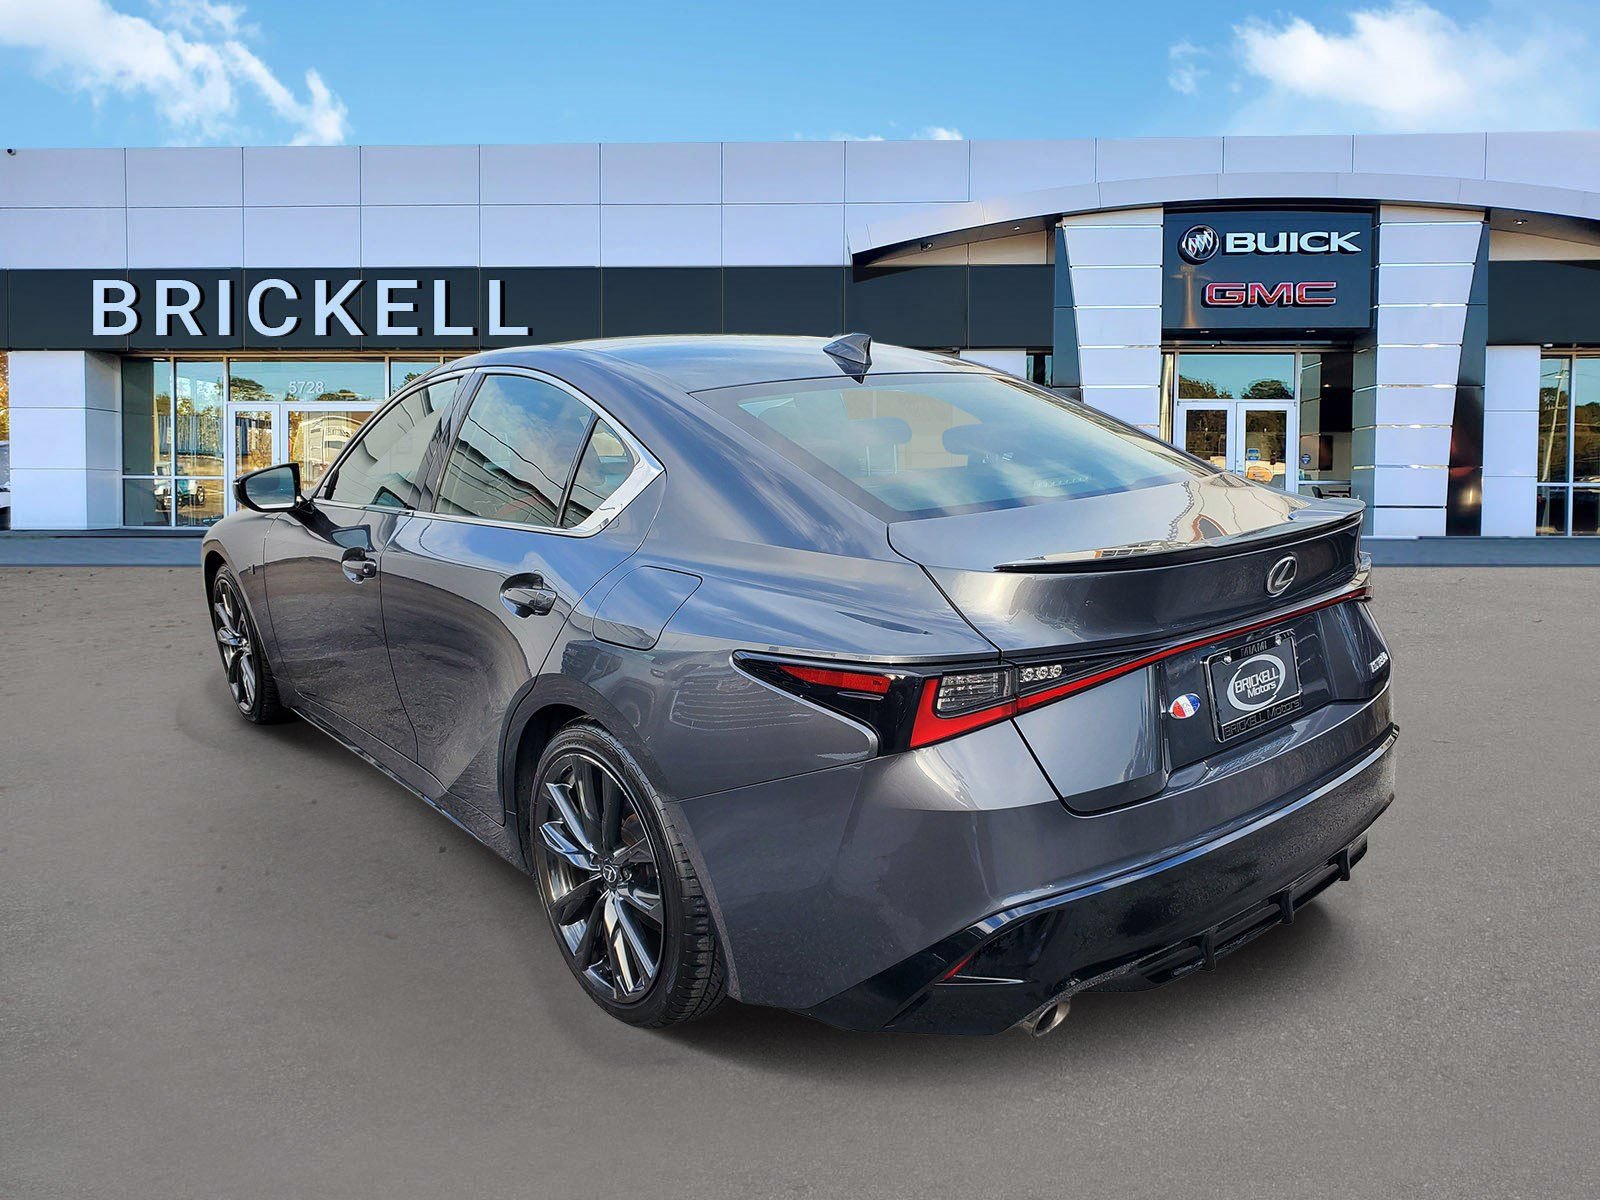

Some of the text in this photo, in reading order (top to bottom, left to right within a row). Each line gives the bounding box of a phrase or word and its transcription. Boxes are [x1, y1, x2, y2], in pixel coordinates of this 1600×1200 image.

[1225, 231, 1362, 253] BUICK
[1205, 281, 1337, 305] GMC
[92, 278, 529, 337] BRICKELL
[289, 381, 325, 394] 5728
[1240, 641, 1268, 656] MIAMI
[1234, 667, 1279, 694] BRICKELL
[1247, 681, 1277, 699] Motors
[1224, 699, 1300, 737] BRICKELL Motors
